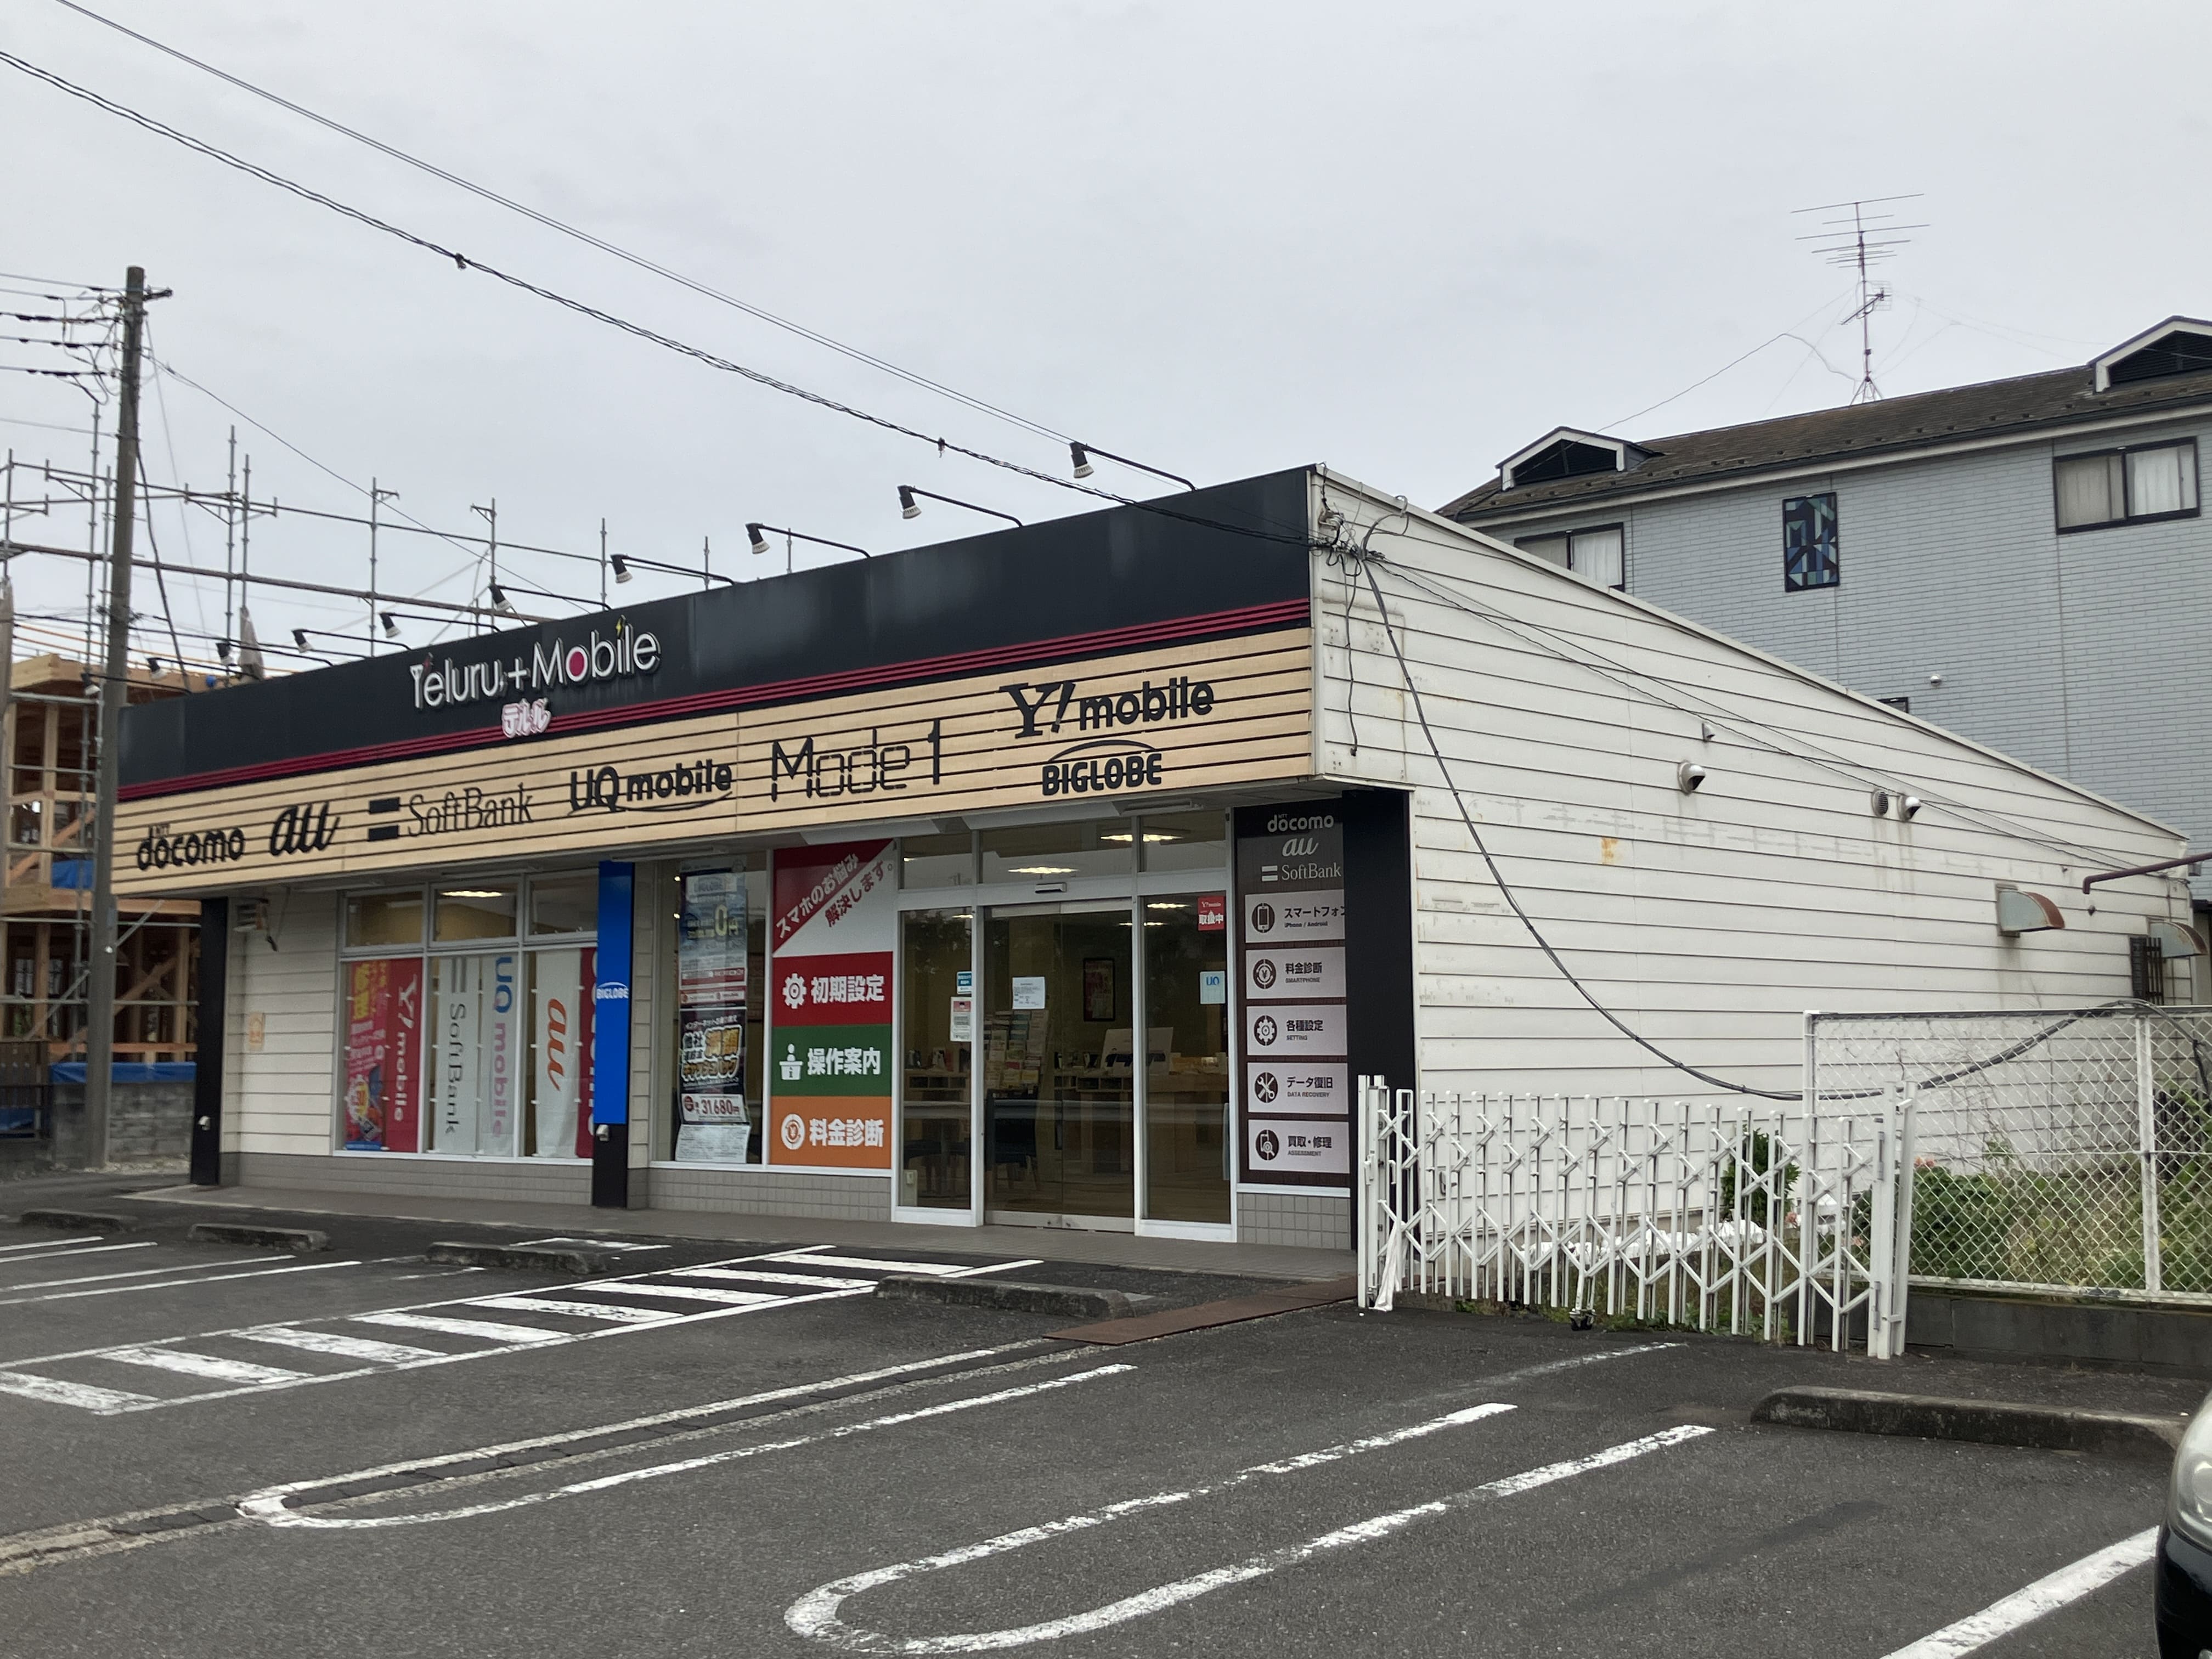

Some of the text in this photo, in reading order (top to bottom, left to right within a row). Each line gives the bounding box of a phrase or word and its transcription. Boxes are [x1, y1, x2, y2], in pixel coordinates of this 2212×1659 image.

[502, 697, 551, 738] テルル
[571, 759, 731, 812] UQ mobile
[1042, 754, 1162, 796] BIGLOBE
[408, 782, 533, 837] SoftBank
[1267, 814, 1334, 833] docomo
[269, 802, 340, 857] au
[138, 825, 245, 871] docomo
[1282, 837, 1319, 856] au
[1282, 862, 1342, 880] SoftBank
[776, 854, 859, 938] スマホのお悩み
[1285, 962, 1322, 974] 料金診断
[596, 988, 629, 999] BIGLOBE
[810, 974, 884, 1004] 初期設定
[1286, 1020, 1323, 1031] 各種設定
[493, 957, 512, 1137] UQ mobile
[548, 998, 567, 1091] au
[445, 1003, 466, 1134] SoftBank
[807, 1047, 881, 1075] 操作案内
[1287, 1077, 1333, 1088] データ復旧
[809, 1118, 884, 1147] 料金診断
[1288, 1136, 1332, 1148] 買取・修理
